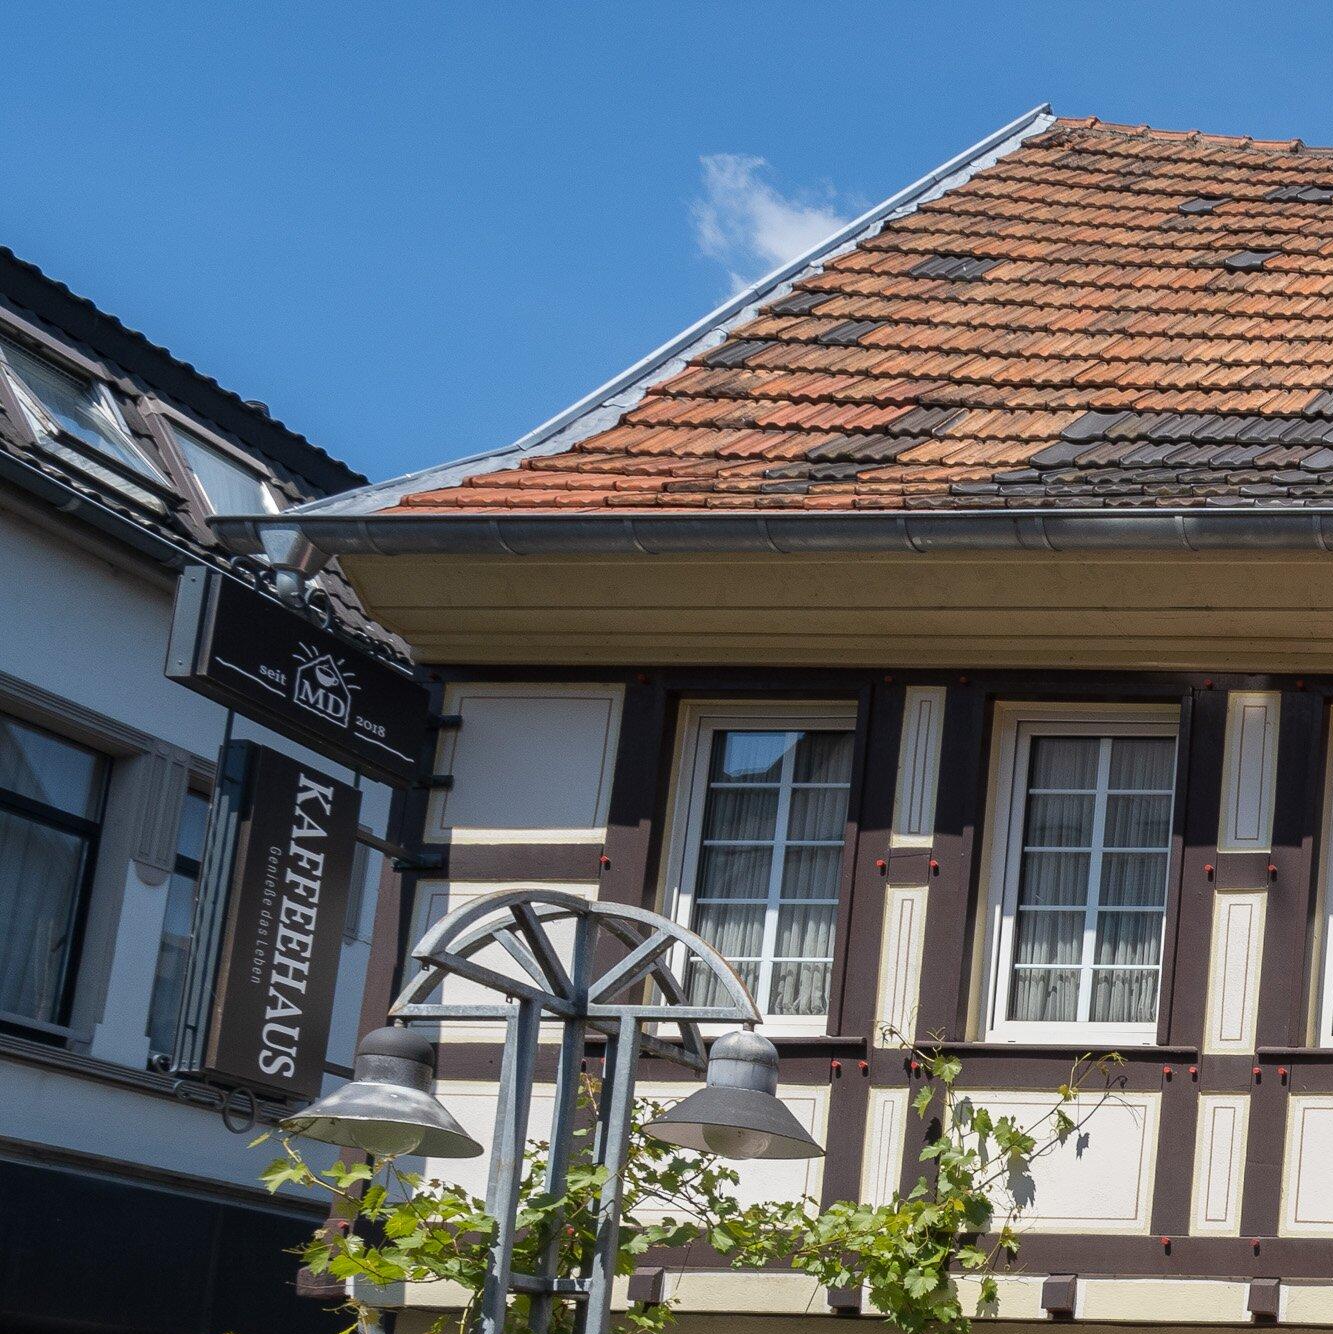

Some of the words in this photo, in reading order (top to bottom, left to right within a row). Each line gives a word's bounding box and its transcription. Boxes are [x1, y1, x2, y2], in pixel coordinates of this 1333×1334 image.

[259, 662, 288, 687] seit
[299, 679, 346, 719] MD
[355, 714, 387, 739] 2018
[262, 845, 282, 906] Genieße
[257, 771, 335, 1080] KAFFEEHAUS
[258, 909, 273, 937] das
[251, 938, 269, 985] Leben
